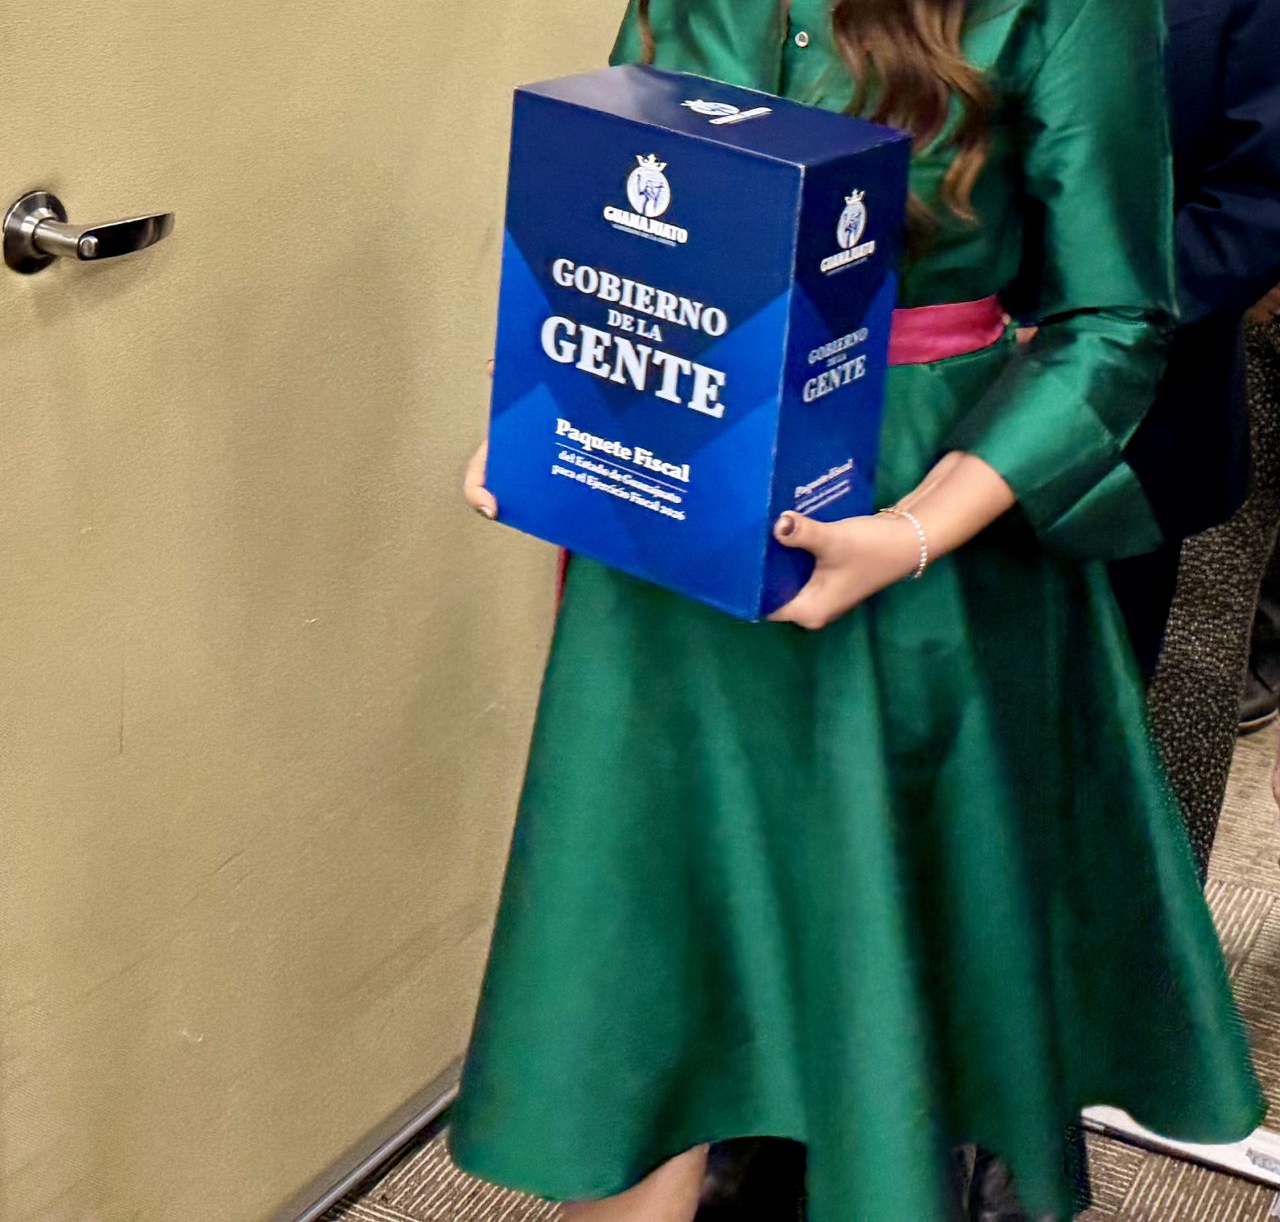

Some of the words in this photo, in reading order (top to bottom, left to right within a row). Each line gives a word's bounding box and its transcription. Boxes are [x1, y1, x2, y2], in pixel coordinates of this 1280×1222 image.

[552, 258, 728, 337] GOBIERNO
[607, 309, 635, 332] DE
[636, 319, 663, 342] LA
[540, 316, 727, 418] GENTE
[803, 354, 866, 403] GENTE
[555, 418, 632, 460] Paquete
[633, 446, 690, 482] Fiscal
